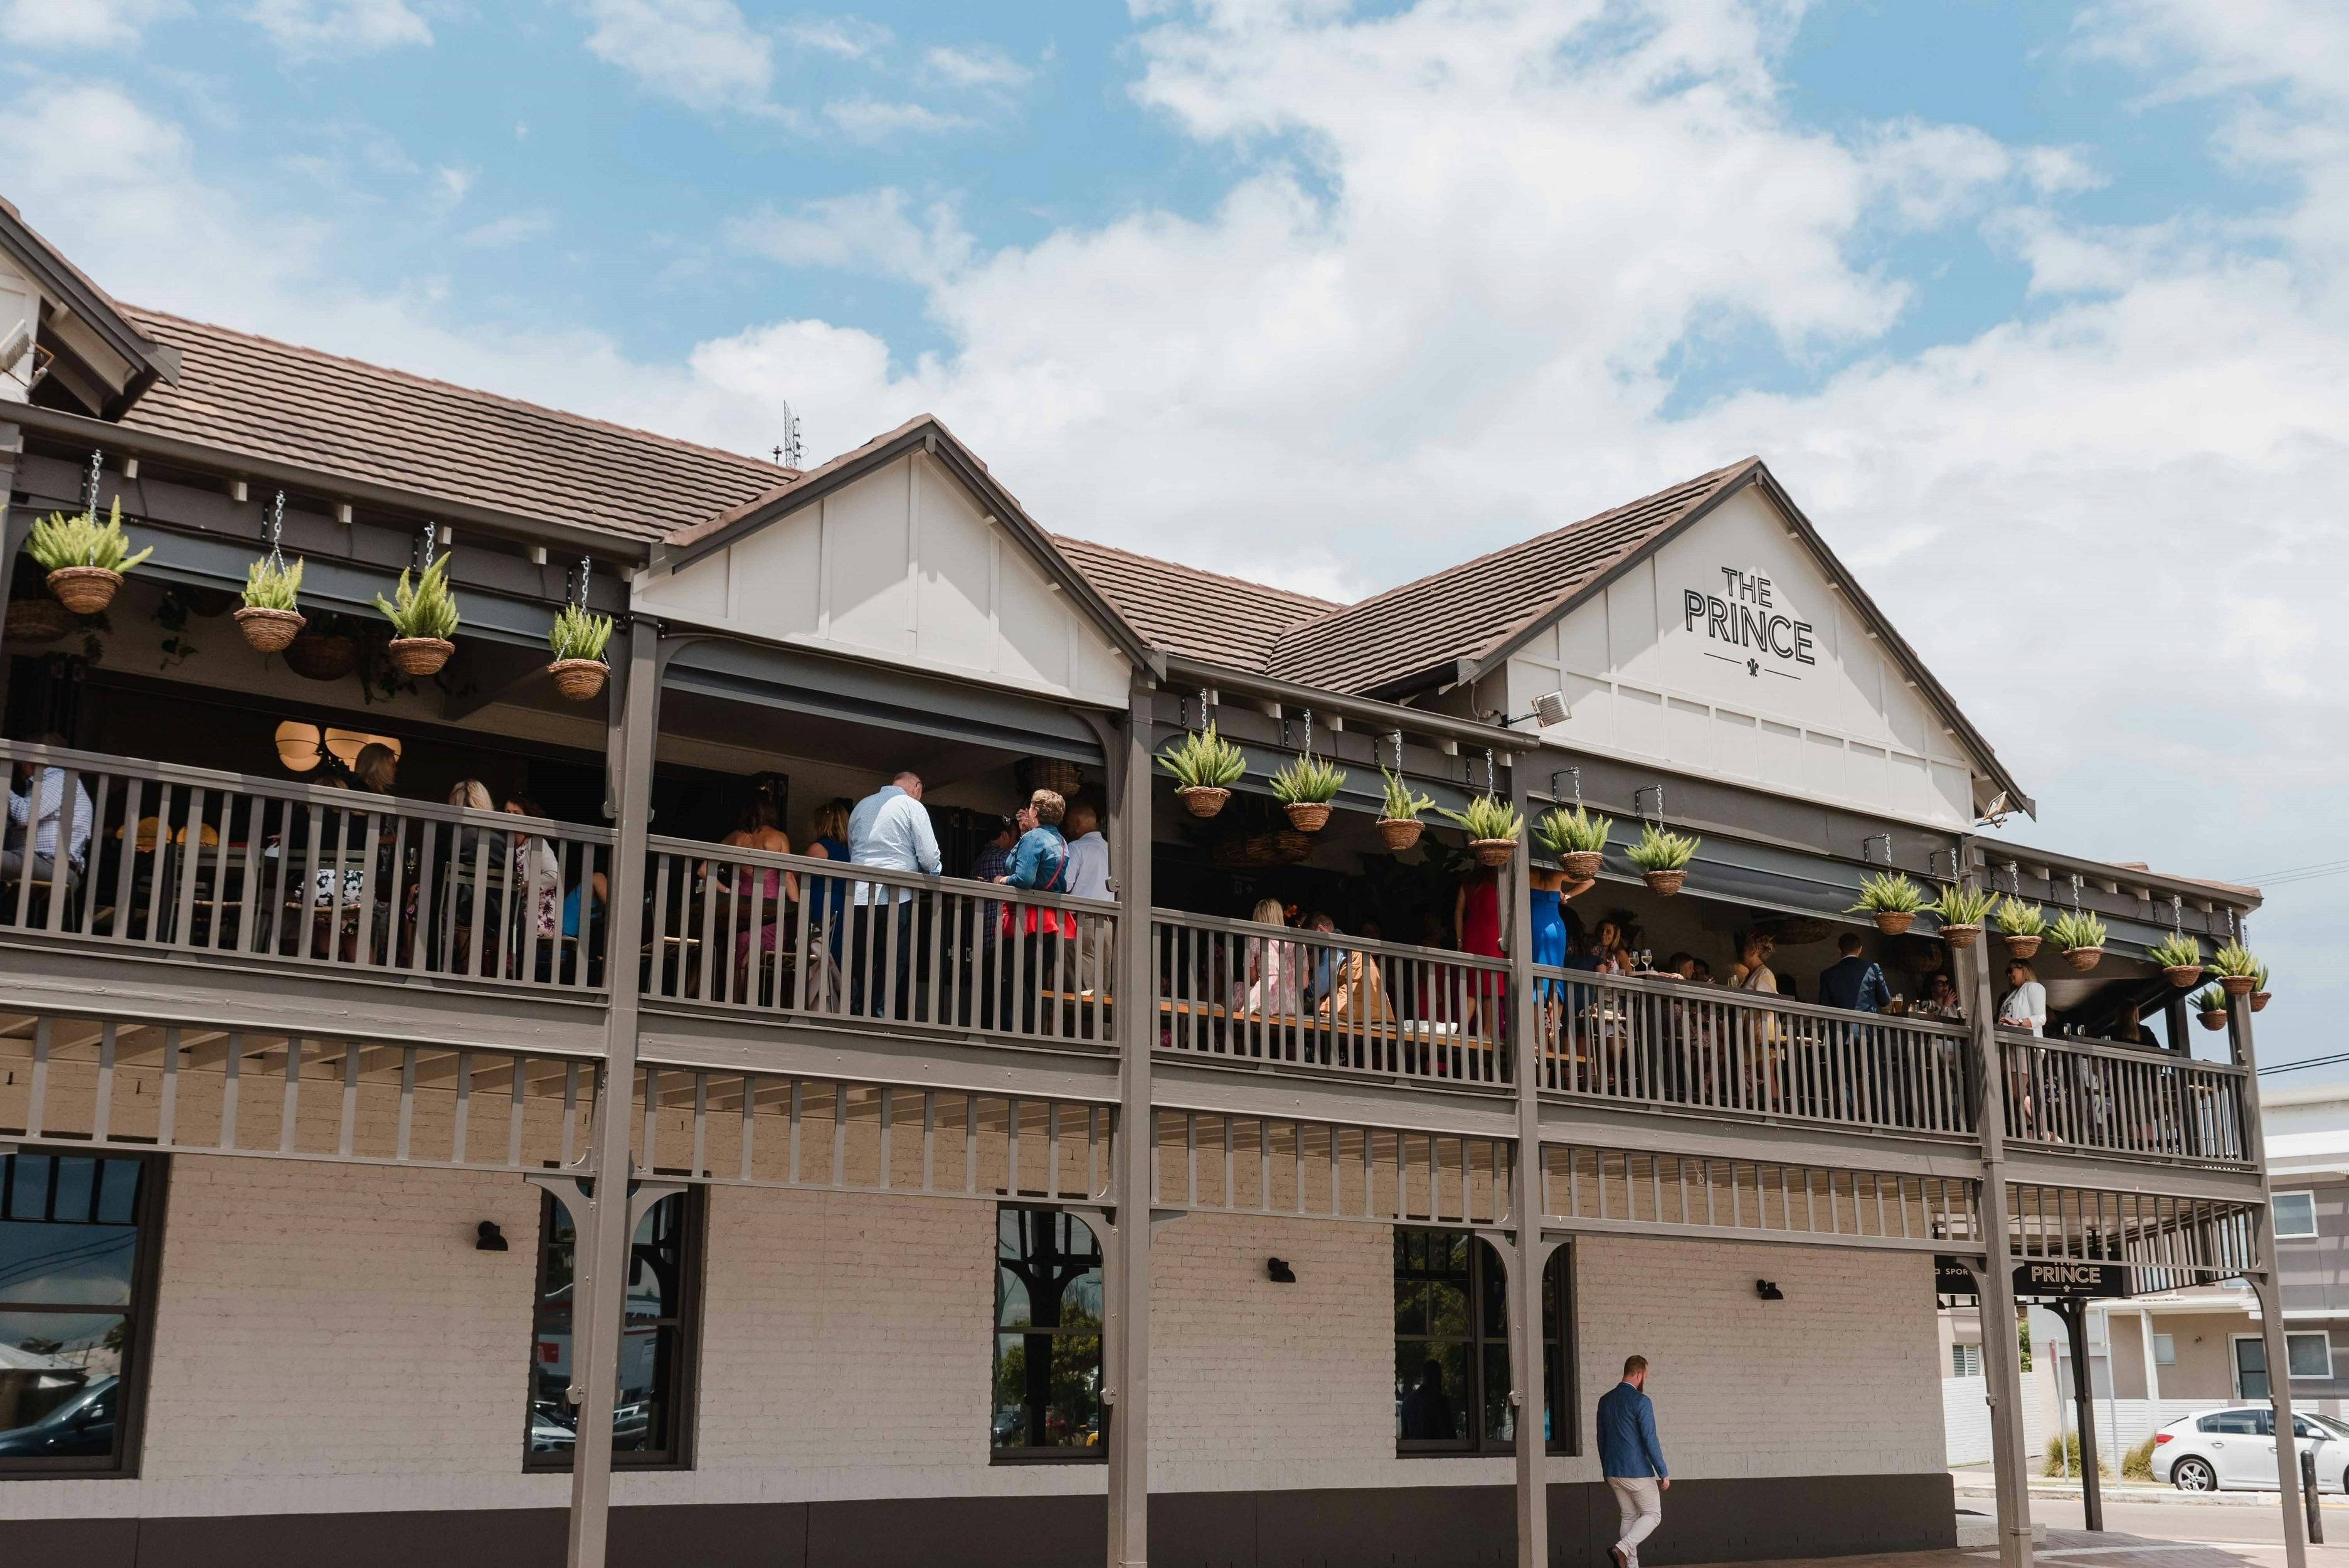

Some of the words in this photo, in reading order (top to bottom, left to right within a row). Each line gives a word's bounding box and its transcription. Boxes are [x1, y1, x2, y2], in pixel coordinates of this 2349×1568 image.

[1721, 566, 1773, 608] THE
[1684, 588, 1815, 666] PRINCE
[2031, 1266, 2101, 1283] PRINCE
